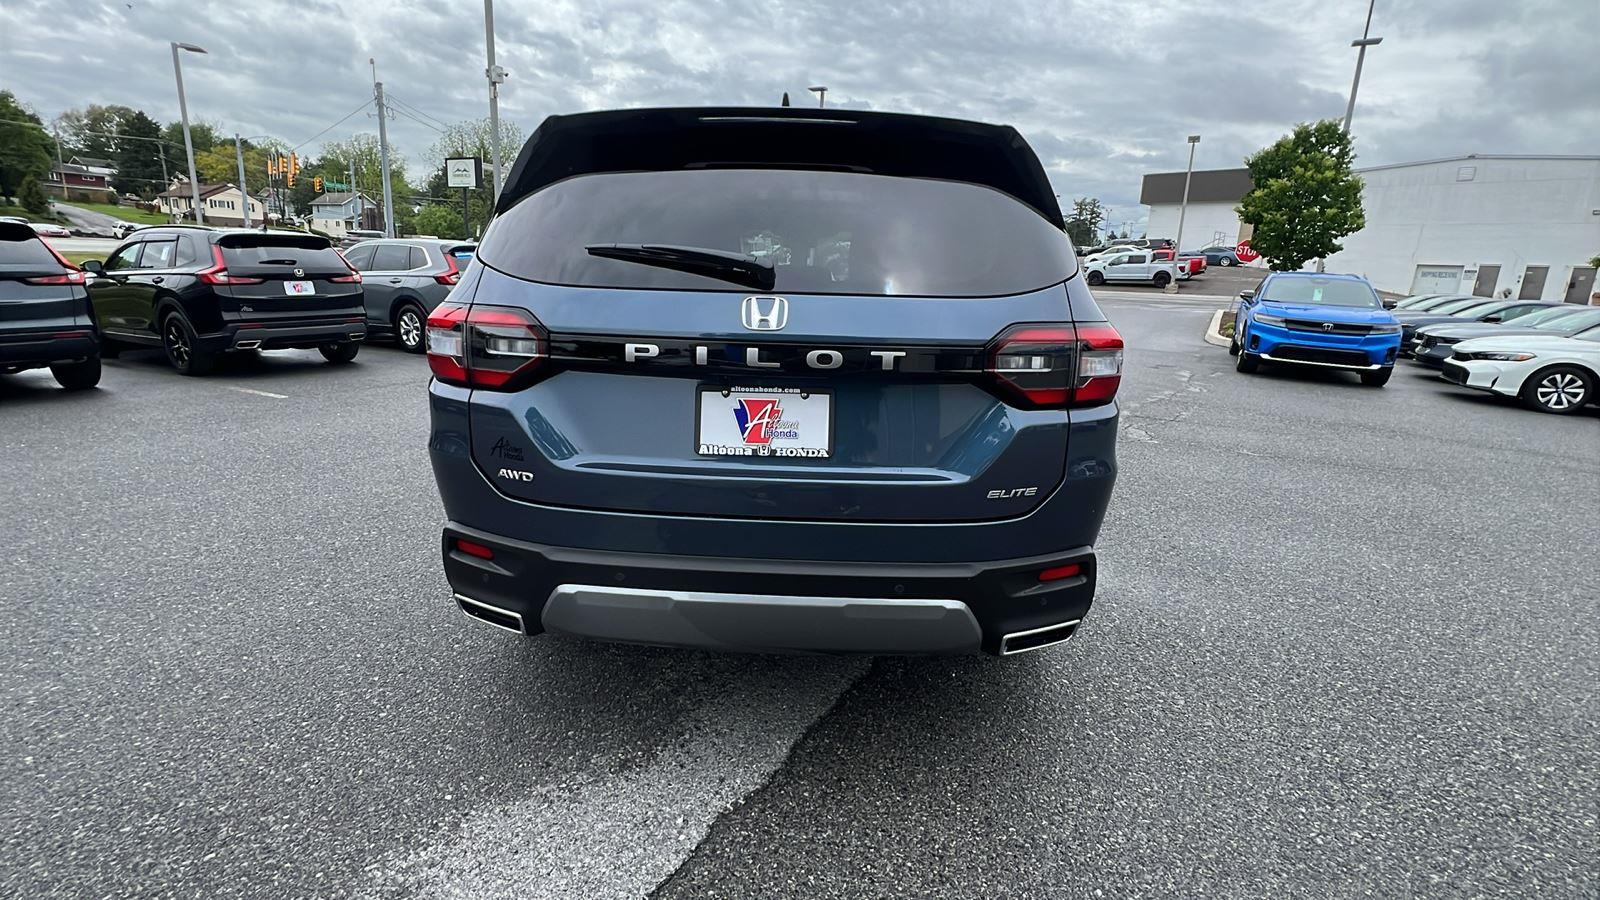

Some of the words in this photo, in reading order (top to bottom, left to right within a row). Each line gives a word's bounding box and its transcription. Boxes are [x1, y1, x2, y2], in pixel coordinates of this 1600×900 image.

[625, 343, 907, 370] PILOT
[730, 385, 801, 393] altoonahonda.com
[765, 427, 798, 438] Honda
[698, 444, 753, 456] Altoona
[775, 446, 829, 458] HONDA
[497, 468, 534, 482] AWD
[986, 486, 1038, 499] ELITE
